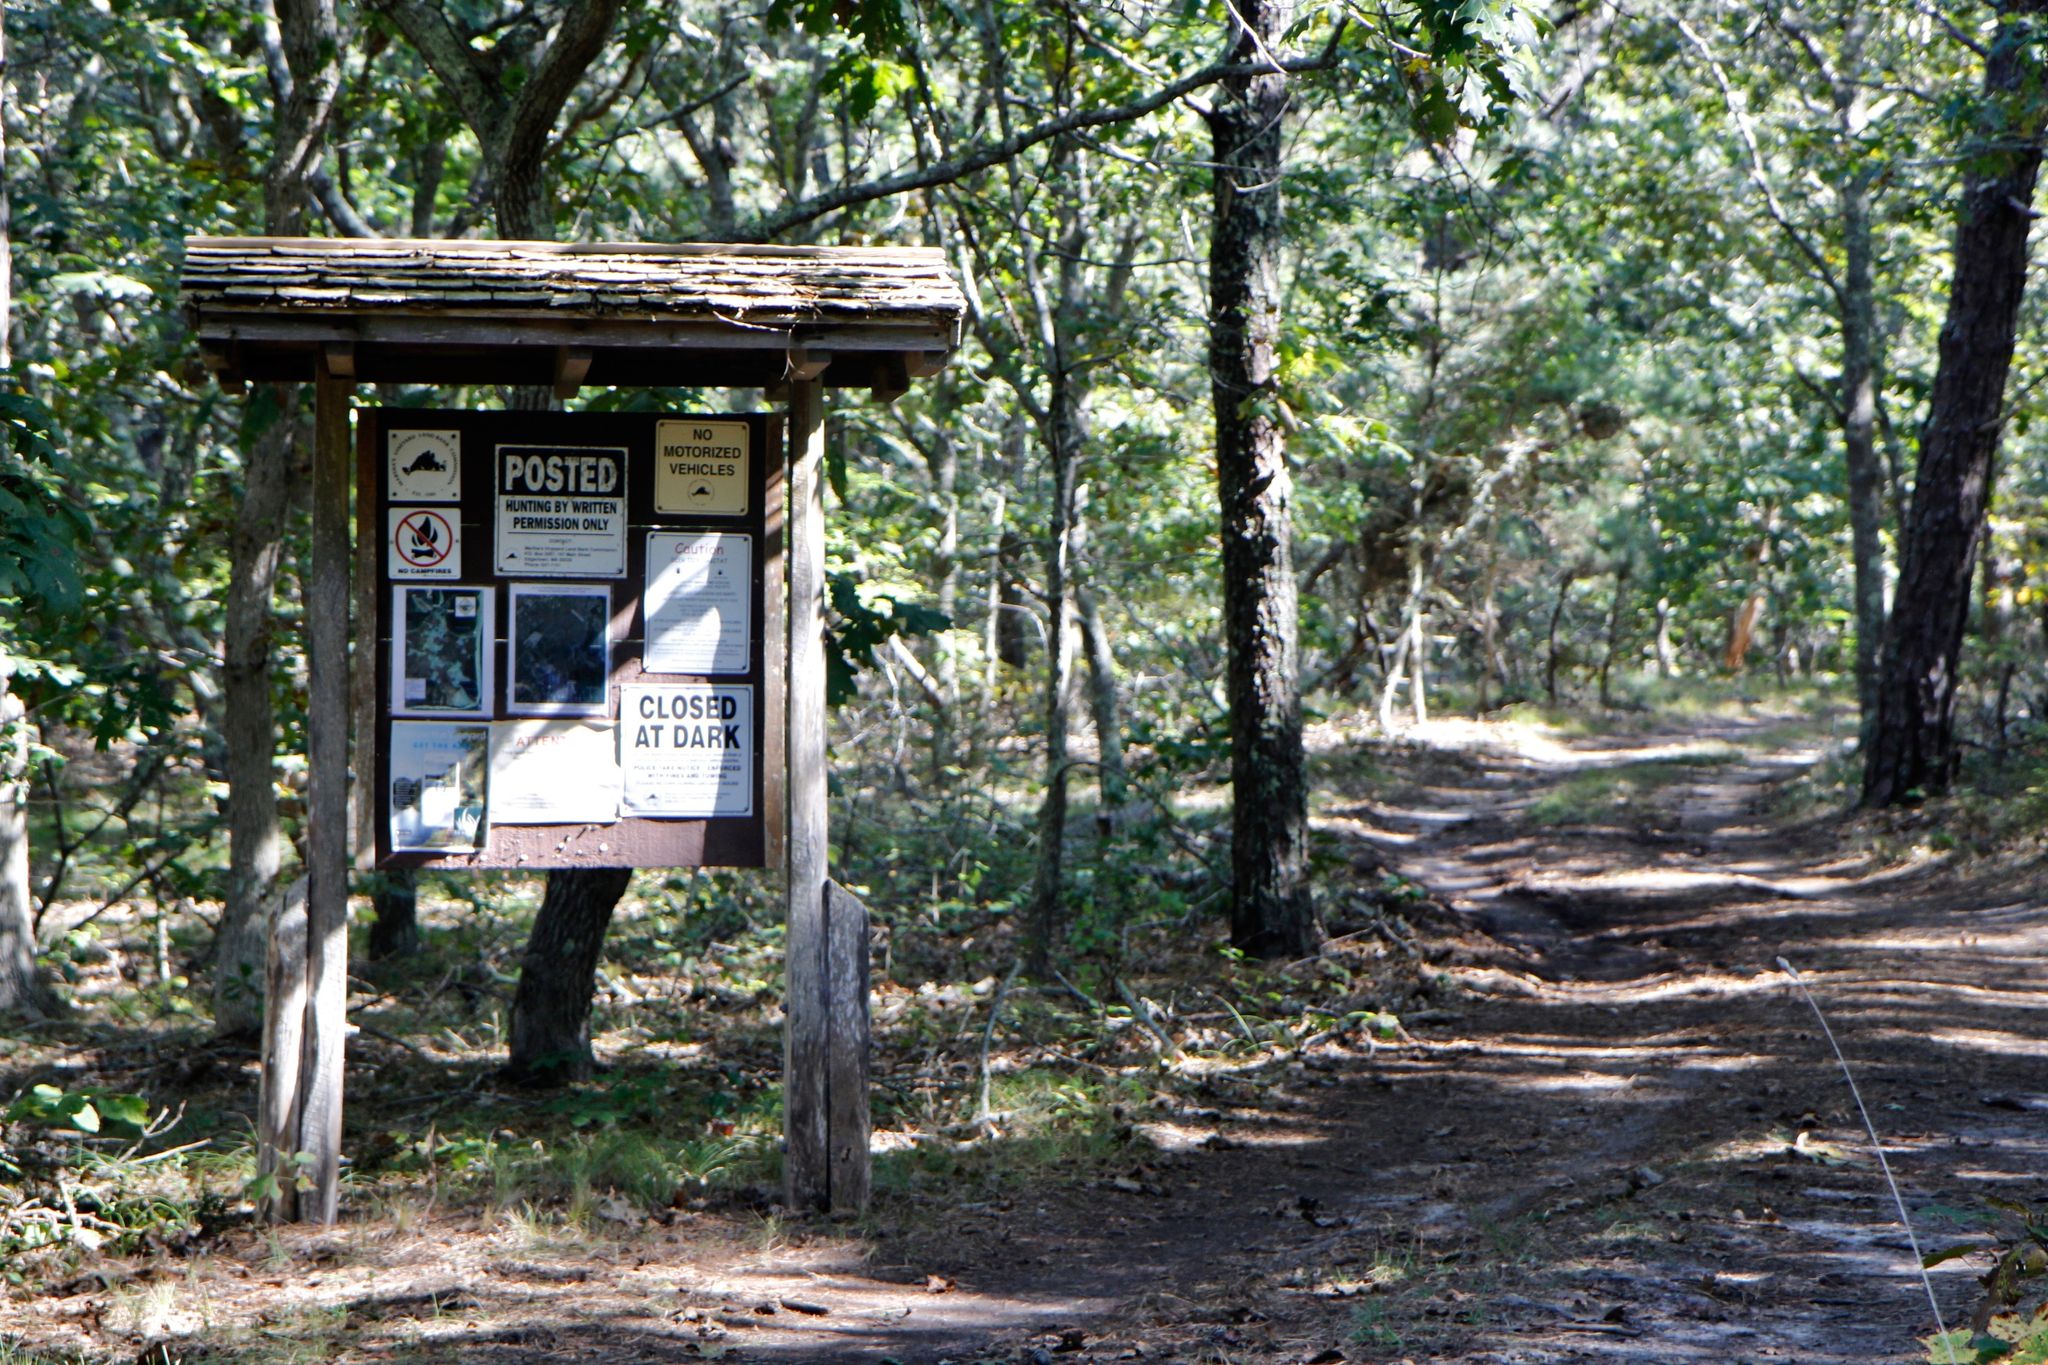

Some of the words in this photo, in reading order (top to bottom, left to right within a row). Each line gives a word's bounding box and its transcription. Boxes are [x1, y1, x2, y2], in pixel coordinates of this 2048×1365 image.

[693, 428, 713, 441] NO
[663, 445, 742, 459] MOTORIZED
[505, 454, 618, 493] POSTED
[669, 463, 736, 477] VEHICLES
[505, 499, 552, 513] HUNTING
[554, 500, 569, 513] BY
[571, 501, 617, 515] WRITTEN
[513, 516, 580, 530] PERMISSION
[582, 518, 609, 531] ONLY
[674, 542, 724, 555] Caution
[397, 567, 409, 575] NO
[410, 567, 452, 575] CAMPFIRES
[639, 695, 737, 720] CLOSED
[635, 724, 664, 748] AT
[673, 724, 741, 749] DARK
